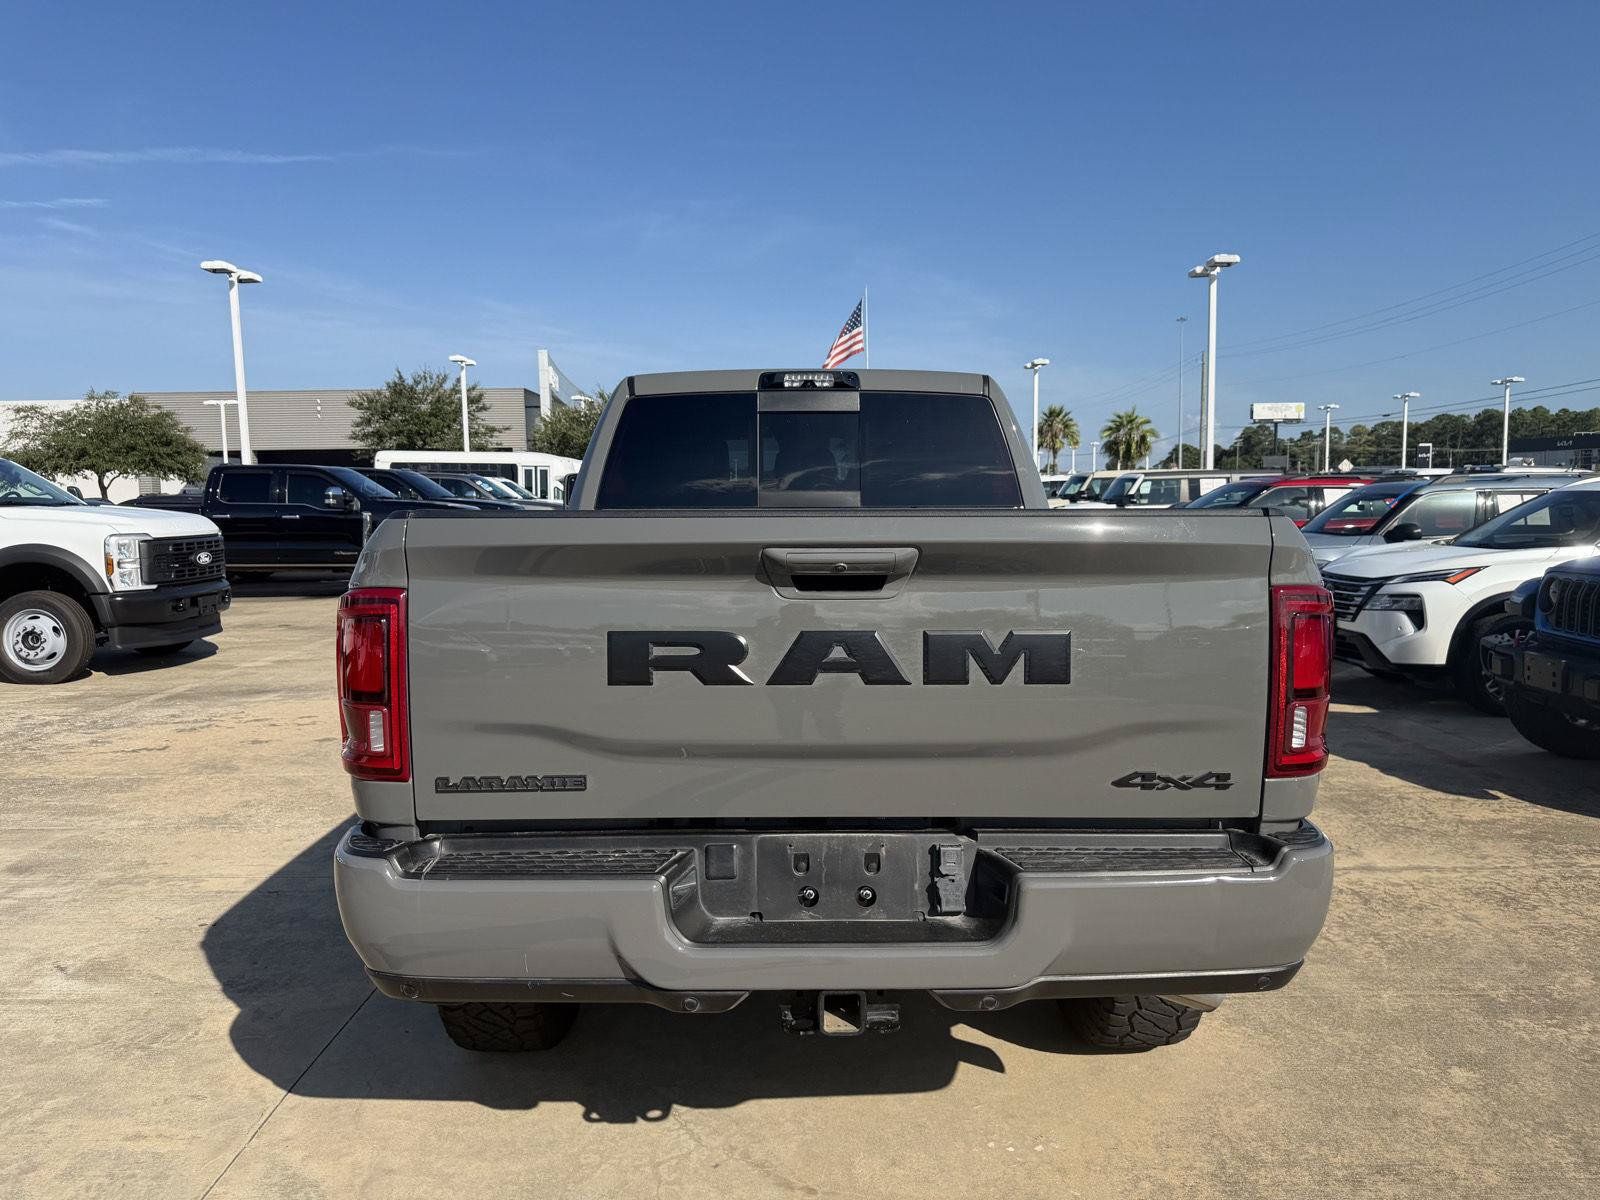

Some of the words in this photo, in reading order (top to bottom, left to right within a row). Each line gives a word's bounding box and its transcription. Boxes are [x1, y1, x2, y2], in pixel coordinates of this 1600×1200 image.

[607, 630, 1071, 686] RAM
[435, 775, 587, 793] LARAMIE
[1110, 771, 1235, 791] 4x4
